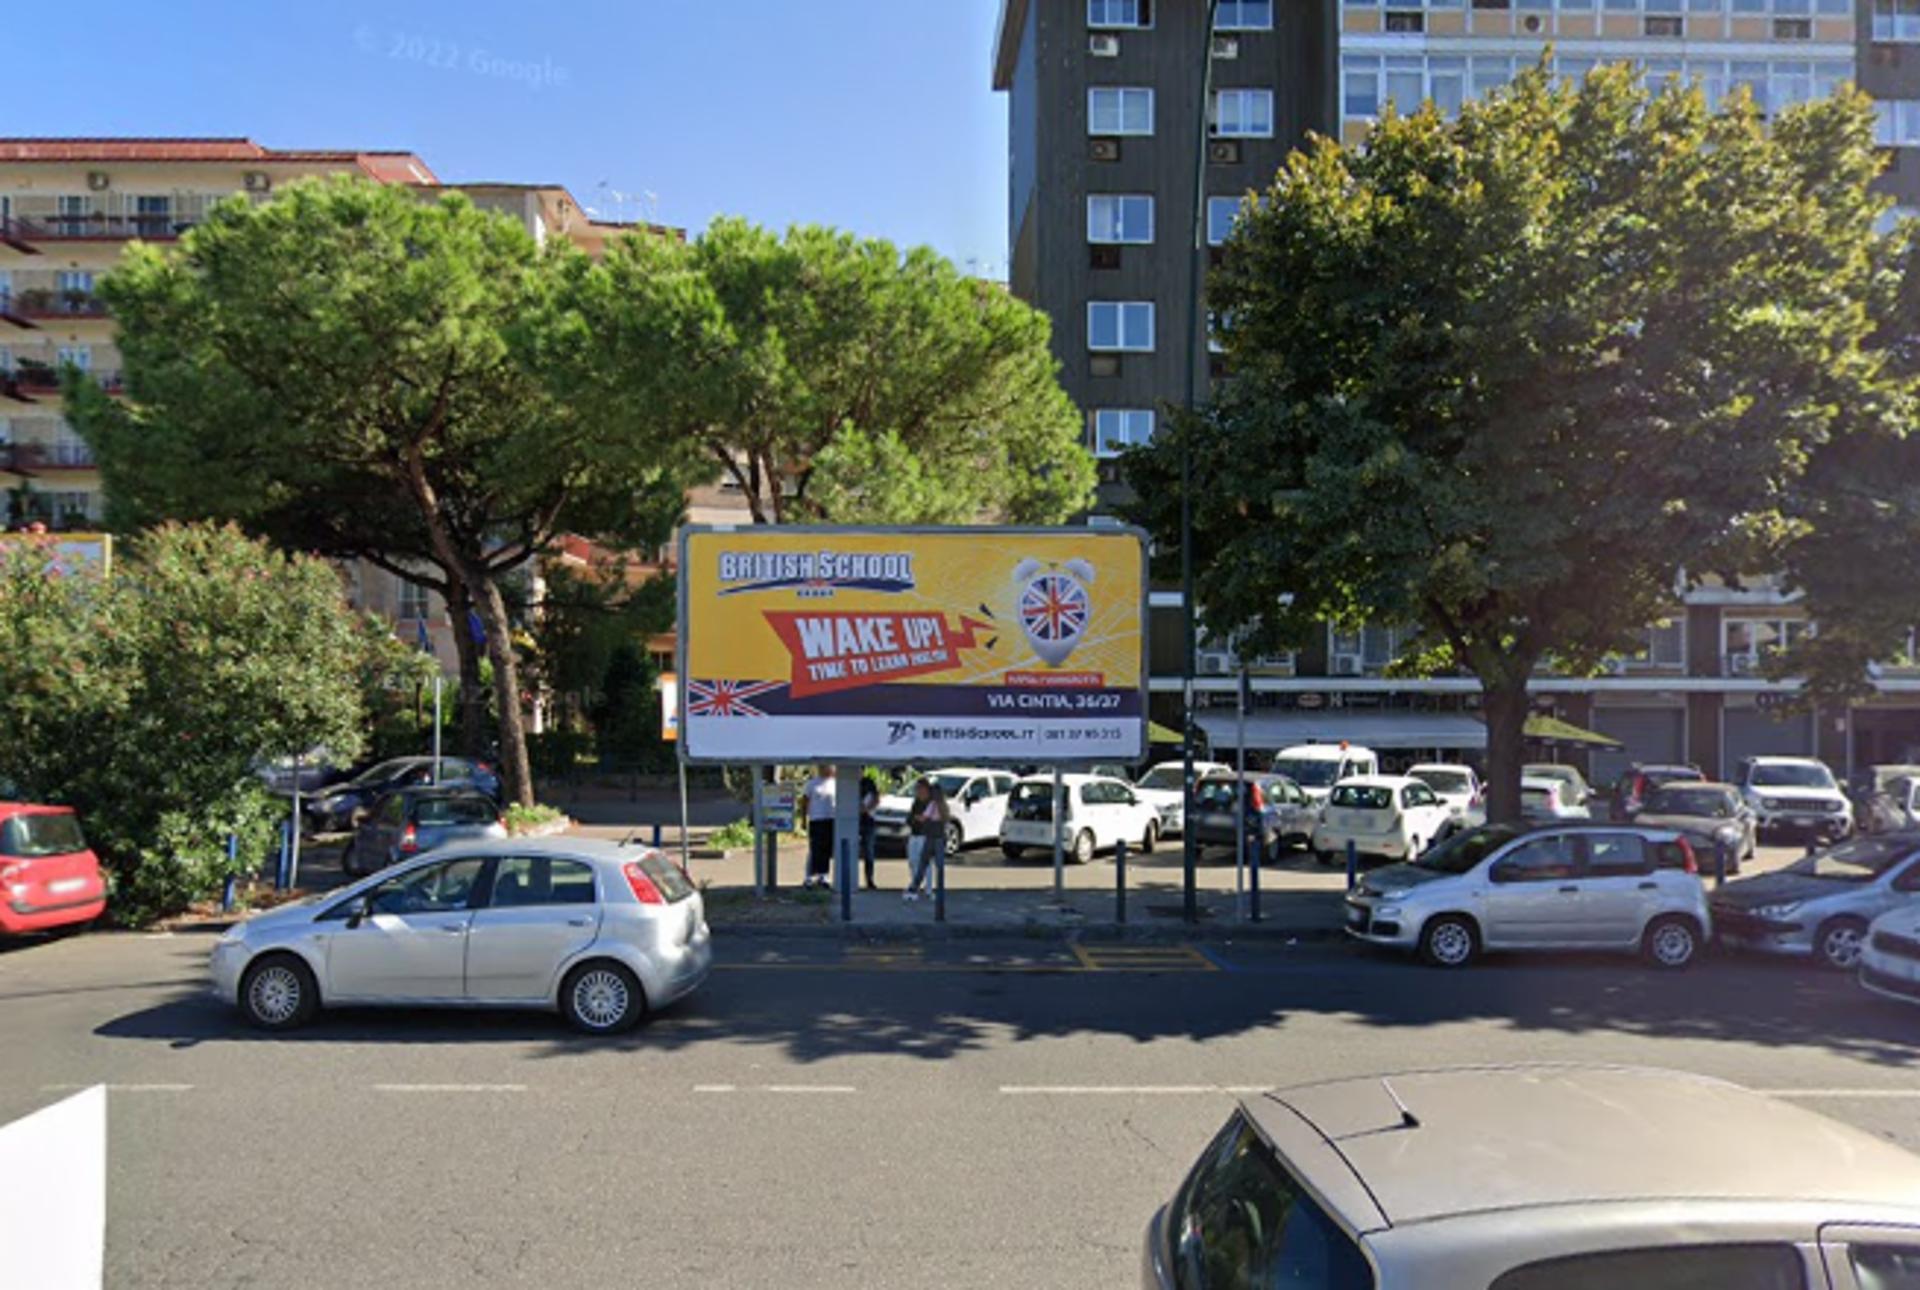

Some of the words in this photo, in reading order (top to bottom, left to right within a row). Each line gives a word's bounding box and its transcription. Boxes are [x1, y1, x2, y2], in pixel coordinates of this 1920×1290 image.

[719, 552, 814, 581] BRITISH
[818, 550, 913, 582] SCHOOL
[795, 617, 898, 659] WAKE
[902, 615, 945, 649] UP!
[807, 661, 848, 681] TIME
[850, 658, 869, 675] TO
[987, 694, 1015, 708] VIA
